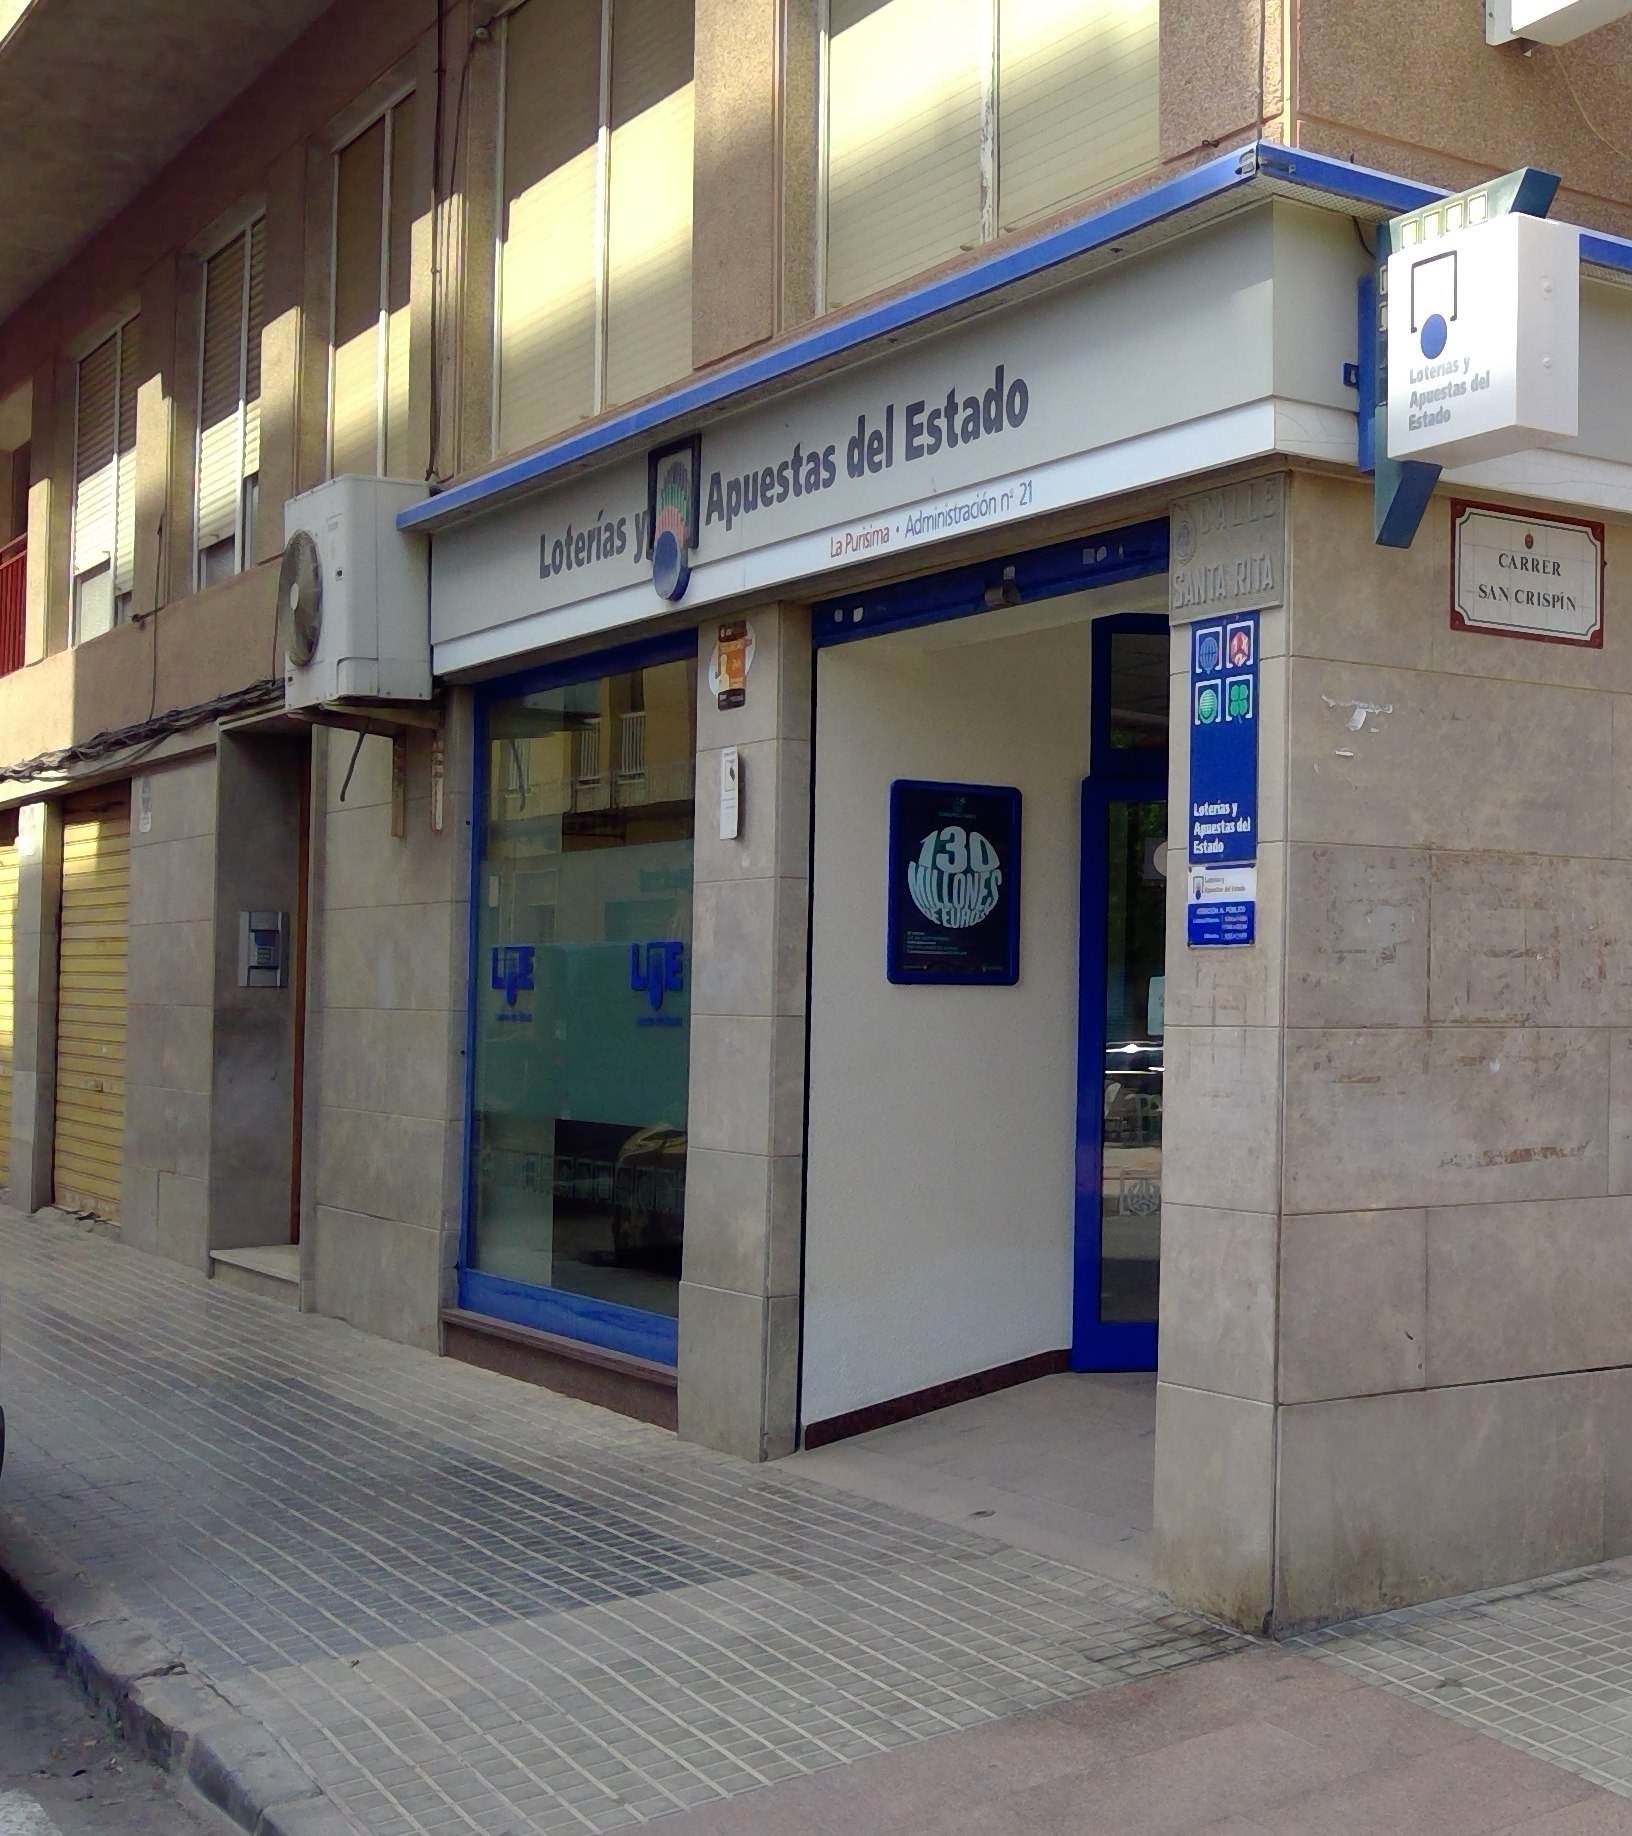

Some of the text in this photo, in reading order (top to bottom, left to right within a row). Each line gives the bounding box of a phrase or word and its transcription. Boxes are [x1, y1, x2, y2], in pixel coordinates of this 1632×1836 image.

[1463, 356, 1470, 375] y
[1409, 370, 1490, 410] Apuestas del
[1408, 405, 1451, 431] Estado
[539, 364, 1028, 579] Loterías y Apuestas del Estado
[831, 536, 843, 558] La
[905, 491, 996, 538] Administración
[1019, 480, 1033, 506] 21
[1498, 553, 1561, 576] CARRER
[1175, 553, 1275, 609] SANTA RITA
[1478, 583, 1576, 611] SAN CRISPÍN
[1232, 803, 1238, 818] y
[1193, 816, 1251, 839] Apuestas del
[919, 826, 1000, 873] 130
[1193, 838, 1225, 855] Estado
[908, 861, 1003, 911] MILLONES
